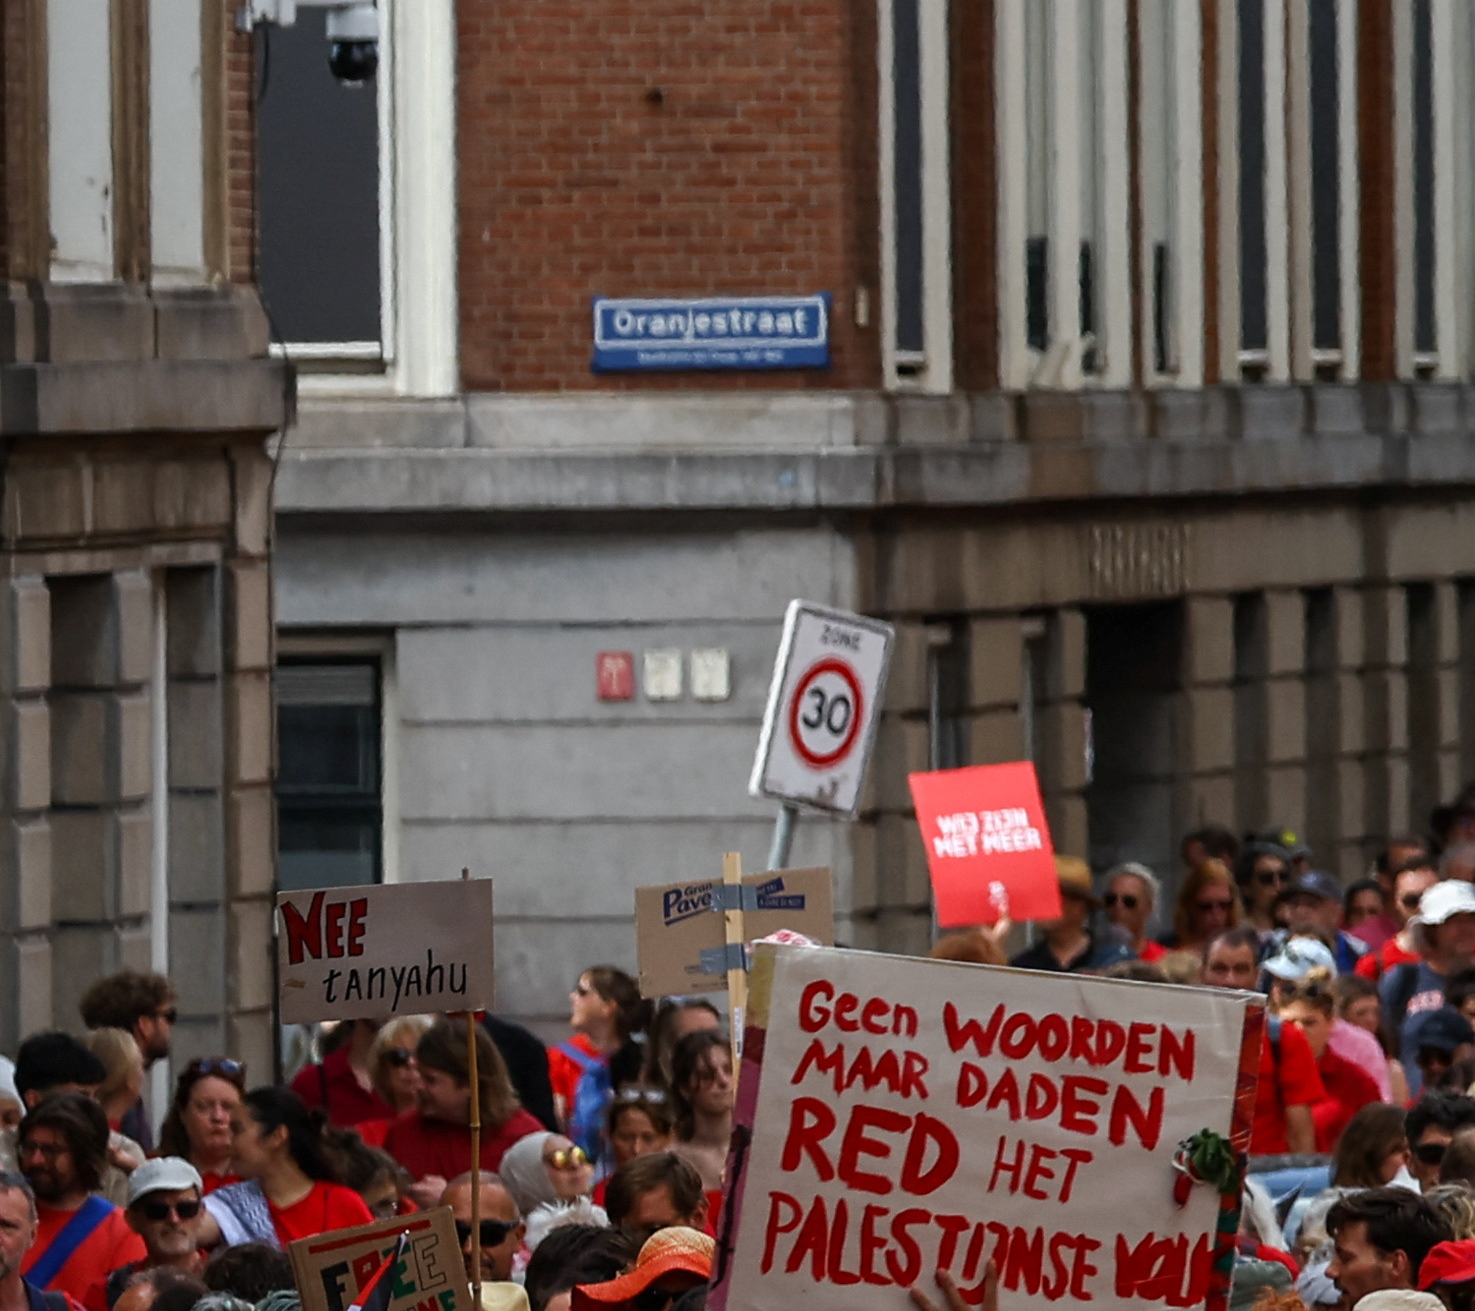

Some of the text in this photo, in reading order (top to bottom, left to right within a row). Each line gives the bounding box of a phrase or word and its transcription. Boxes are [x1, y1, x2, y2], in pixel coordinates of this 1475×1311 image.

[614, 307, 807, 343] Oranjestraat
[821, 625, 862, 650] ZONE
[801, 687, 852, 737] 30
[936, 808, 1029, 834] WIJ ZIJN
[982, 827, 1042, 855] MEER
[280, 891, 368, 965] NEE
[663, 889, 713, 920] Pave
[799, 979, 1196, 1082] Geen WOORDEN
[790, 1038, 1165, 1152] MAAR DADEN
[781, 1096, 1093, 1204] RED HET
[760, 1191, 1102, 1305] PALESTIJNSE
